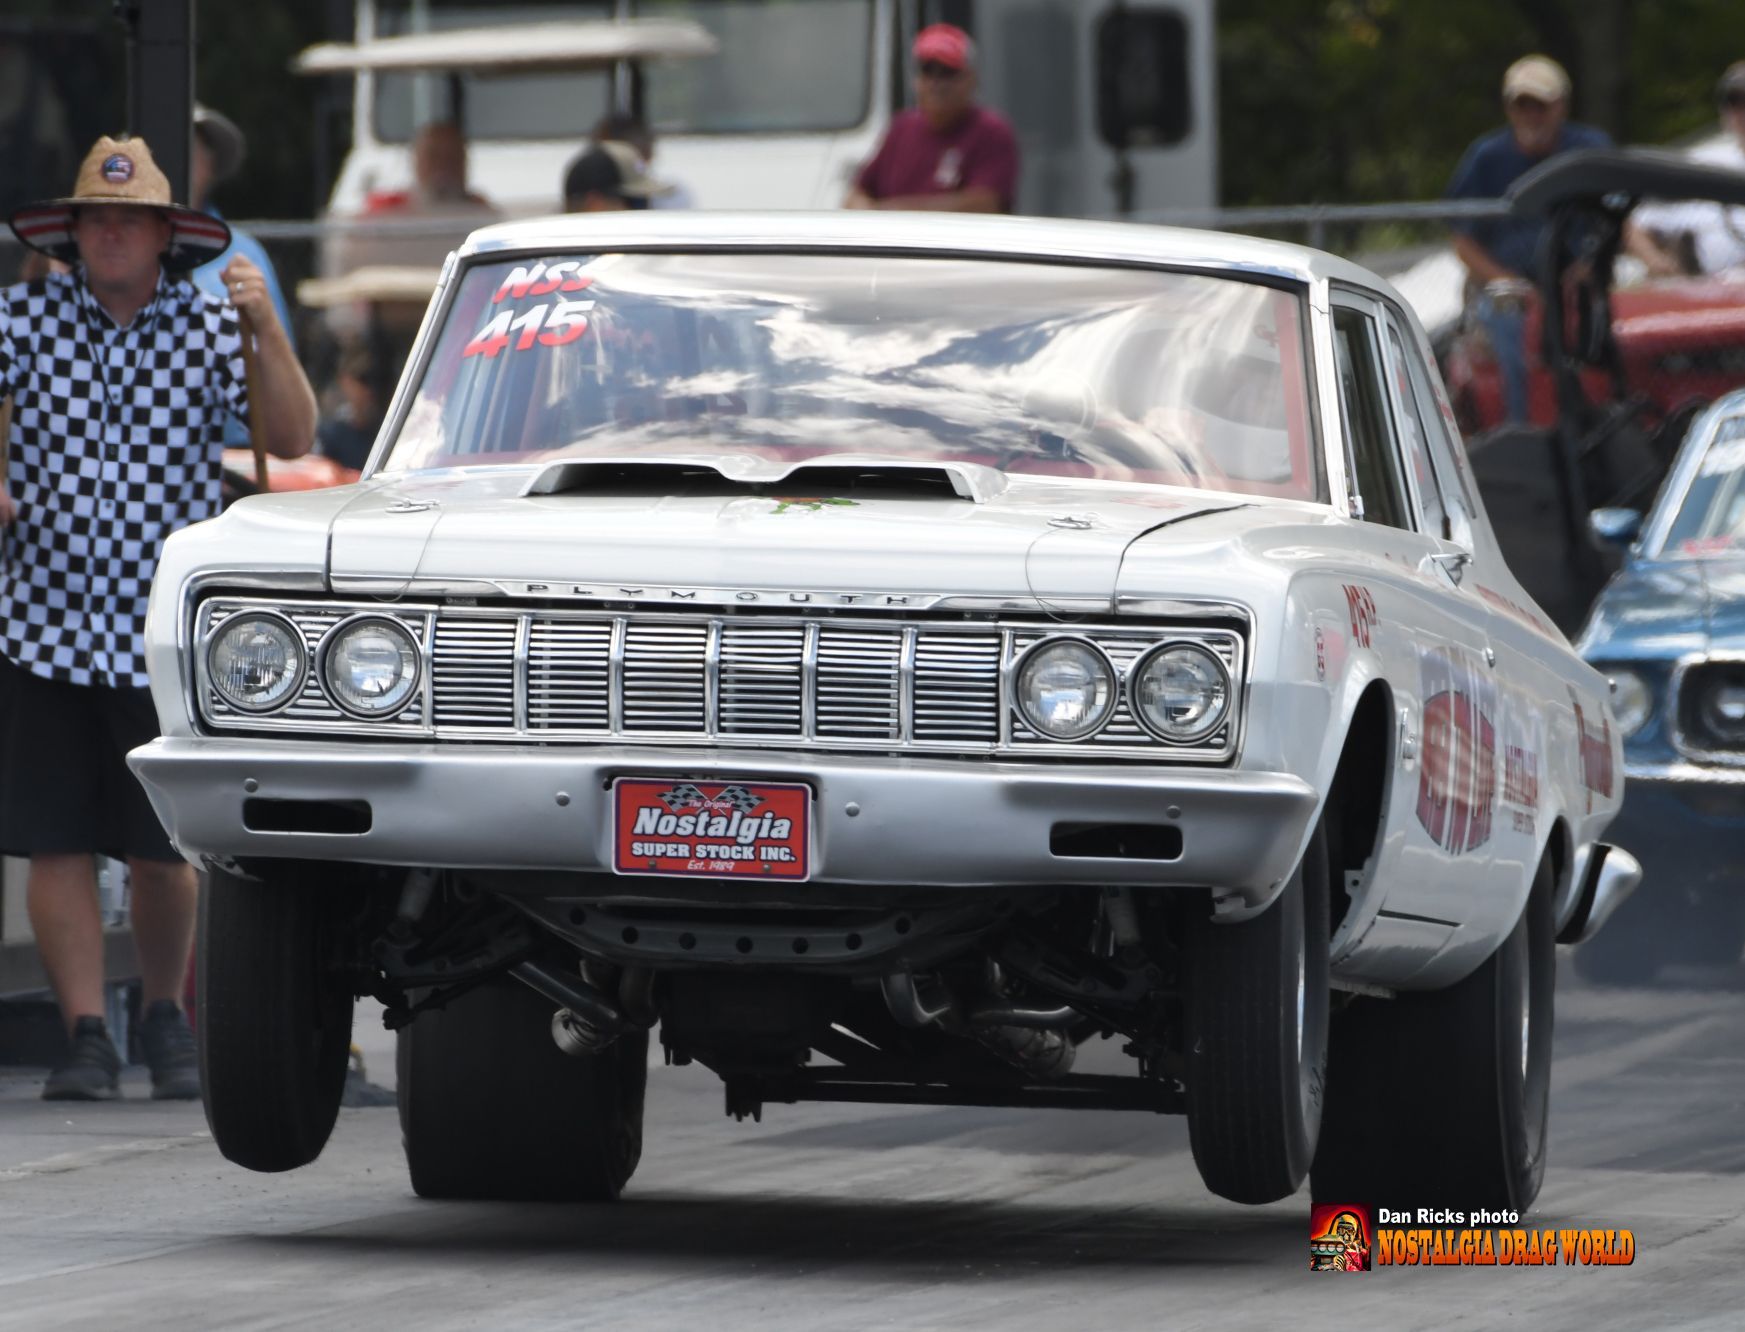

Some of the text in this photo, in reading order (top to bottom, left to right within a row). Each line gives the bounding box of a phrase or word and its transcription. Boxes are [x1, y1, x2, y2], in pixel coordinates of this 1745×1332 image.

[491, 261, 597, 304] NSS
[463, 300, 596, 359] 415
[527, 583, 908, 604] PLYMOUTH
[632, 806, 792, 844] Nostalgia
[632, 842, 796, 861] SUPER STOCK INC.
[687, 860, 705, 870] Est.
